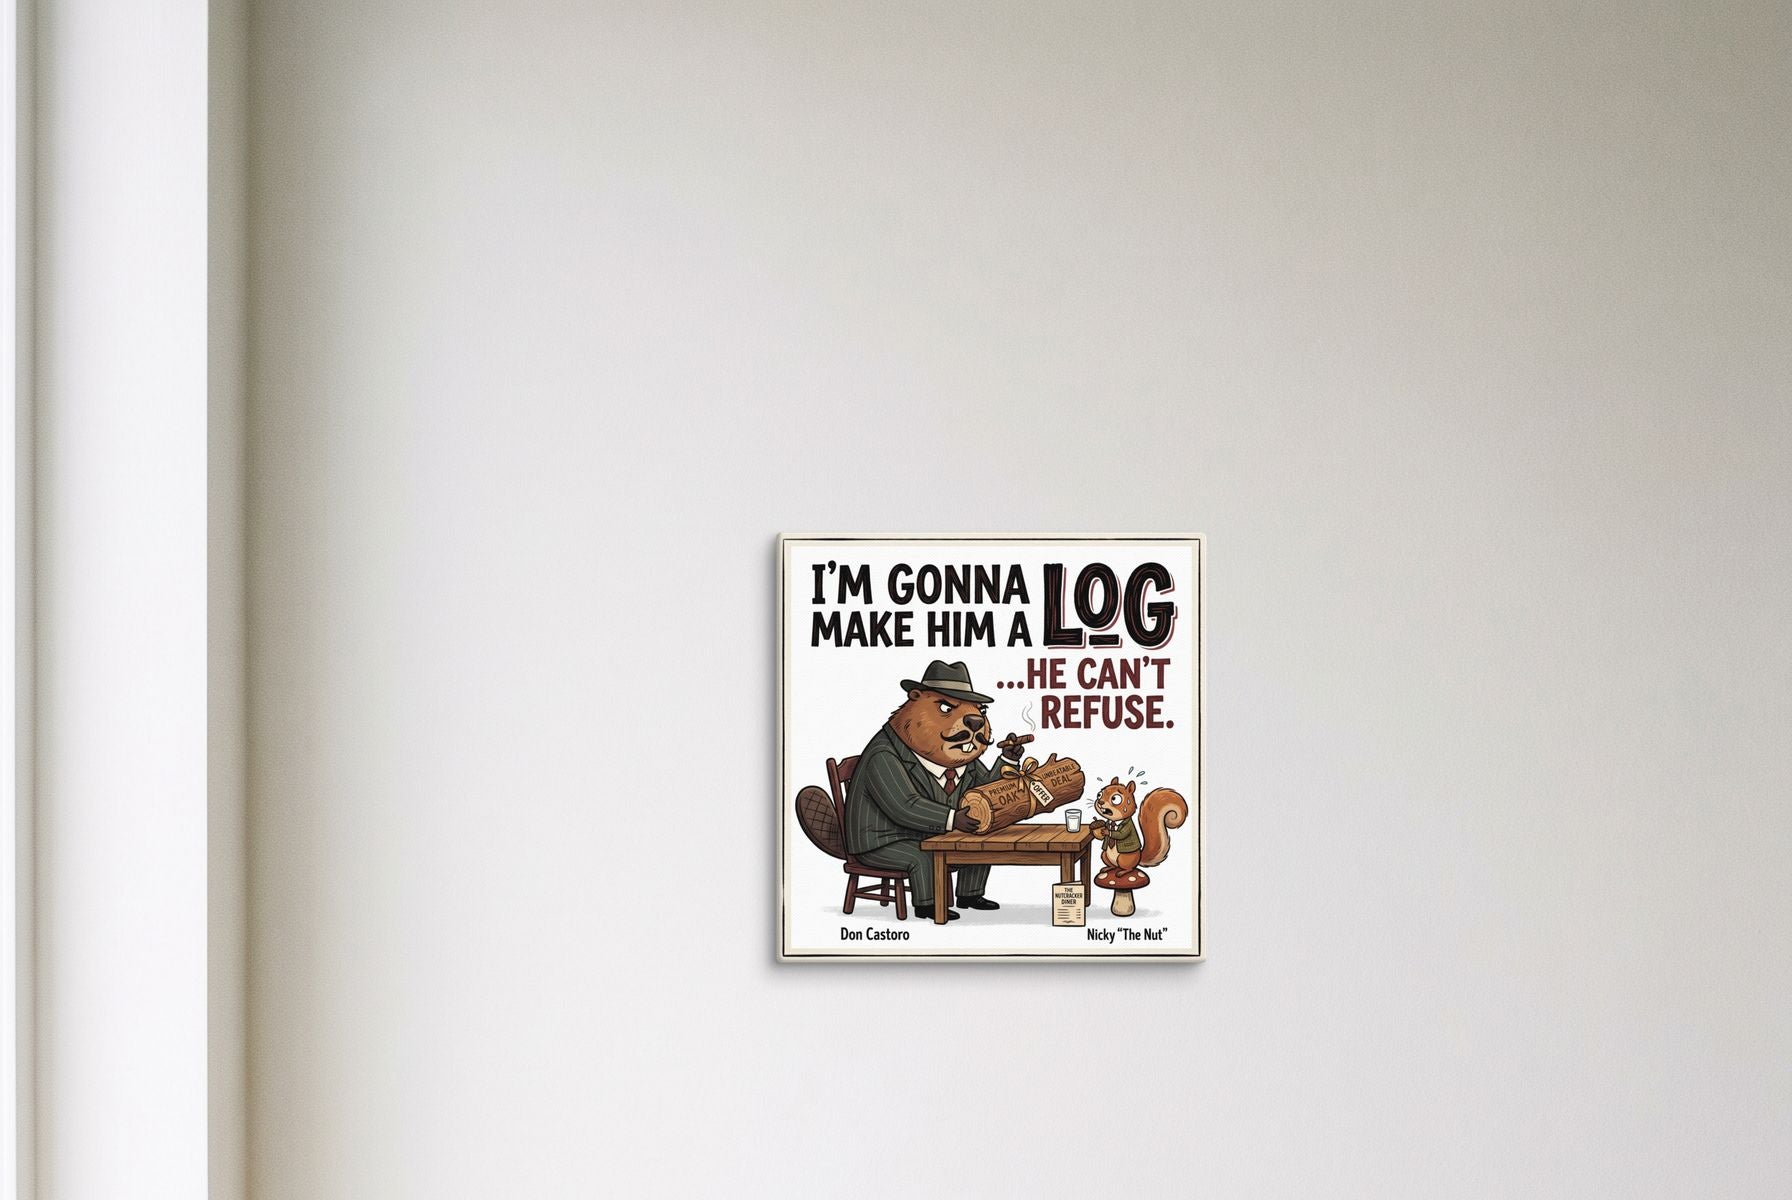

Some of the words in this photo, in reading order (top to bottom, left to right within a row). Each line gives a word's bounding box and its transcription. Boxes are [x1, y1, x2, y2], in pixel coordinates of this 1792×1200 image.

[812, 560, 873, 605] I'M
[888, 563, 1031, 605] GONNA
[1043, 562, 1178, 651] LOG
[811, 611, 914, 648] MAKE
[928, 611, 996, 648] HIM
[1007, 611, 1033, 648] A
[997, 658, 1067, 690] ...HE
[1077, 656, 1171, 690] CAN'T
[1041, 694, 1175, 730] REFUSE.
[1042, 764, 1076, 779] UNBEATABLE
[1050, 774, 1073, 787] DEAL
[988, 782, 1017, 797] PREMIUM
[998, 790, 1021, 806] OAK
[1033, 784, 1051, 803] OFFER
[840, 927, 863, 940] Don
[866, 927, 910, 940] Castoro
[1087, 928, 1115, 944] Nicky
